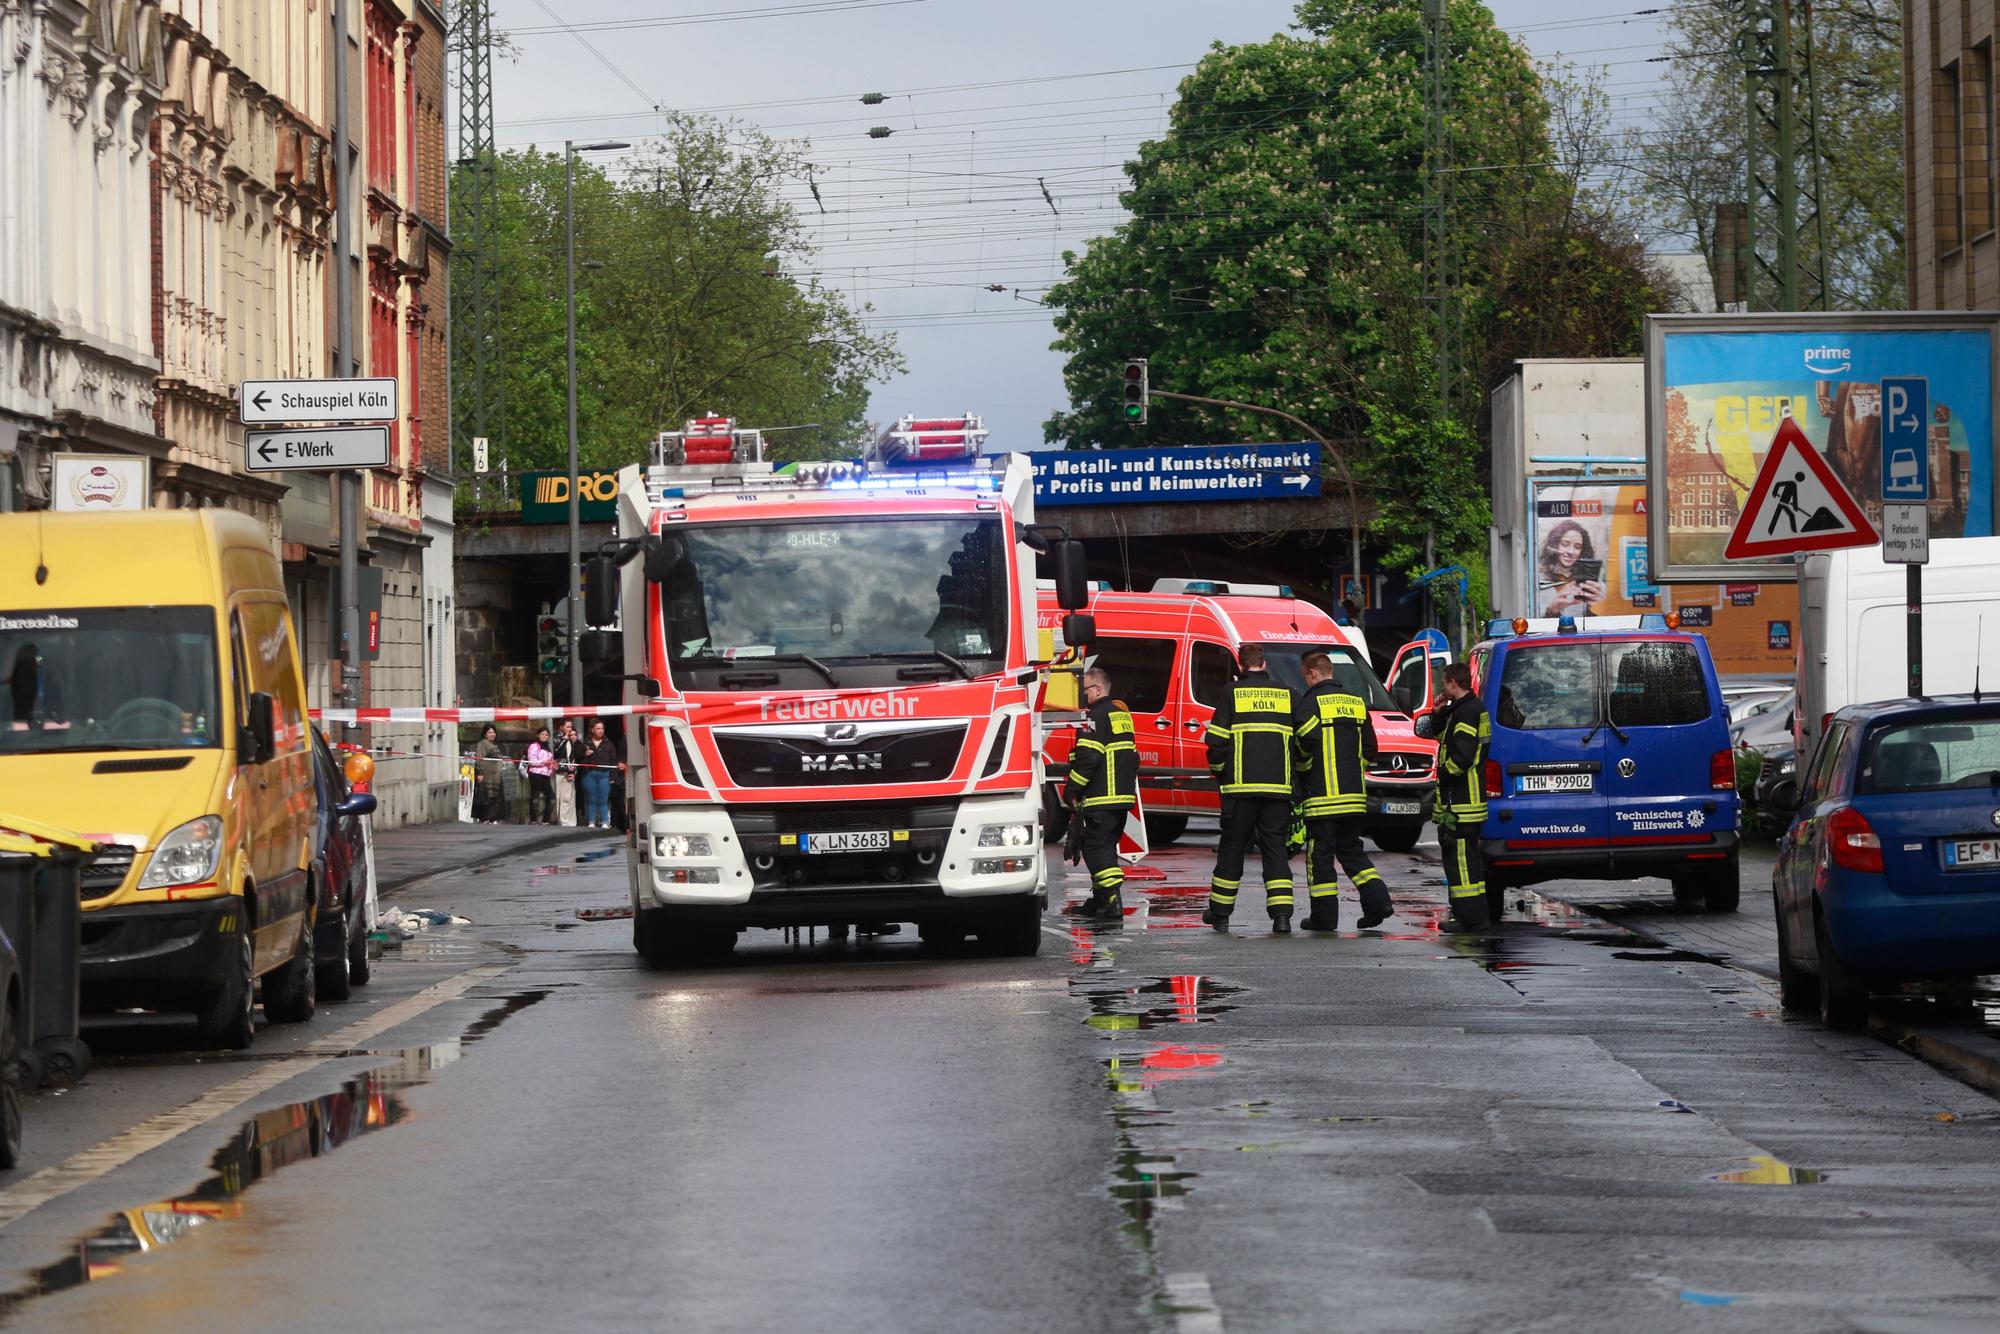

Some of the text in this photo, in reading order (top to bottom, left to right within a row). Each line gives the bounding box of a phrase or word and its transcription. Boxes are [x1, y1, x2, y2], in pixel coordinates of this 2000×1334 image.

[1804, 346, 1851, 362] prime
[281, 391, 387, 411] Schauspiel Köln
[1889, 387, 1908, 433] P
[285, 440, 334, 458] E-Werk
[478, 440, 484, 453] 4
[478, 455, 484, 469] 6
[1031, 452, 1311, 476] er Metall- und Kunststoffmarkt
[550, 472, 619, 503] DRÖ
[1050, 479, 1103, 494] Profis
[1111, 477, 1142, 492] und
[1149, 473, 1263, 490] Heimwerker!
[1551, 503, 1599, 515] ALDI TALK
[1901, 511, 1910, 520] mit
[1892, 524, 1919, 534] Parkschein
[1260, 631, 1338, 644] Einsatzleitung
[1235, 689, 1289, 699] BERUFSFEUERWEHR
[760, 691, 920, 721] Feuerwehr
[1252, 699, 1276, 710] KÖLN
[1336, 705, 1355, 716] KÖLN
[802, 753, 882, 772] MAN
[1526, 775, 1590, 789] THW 99902
[1616, 810, 1683, 821] Technisches
[1521, 824, 1586, 834] www.thw.de
[1632, 820, 1684, 830] Hilfswerk
[809, 835, 819, 850] K
[851, 833, 888, 847] 3683
[1957, 843, 1981, 862] EF
